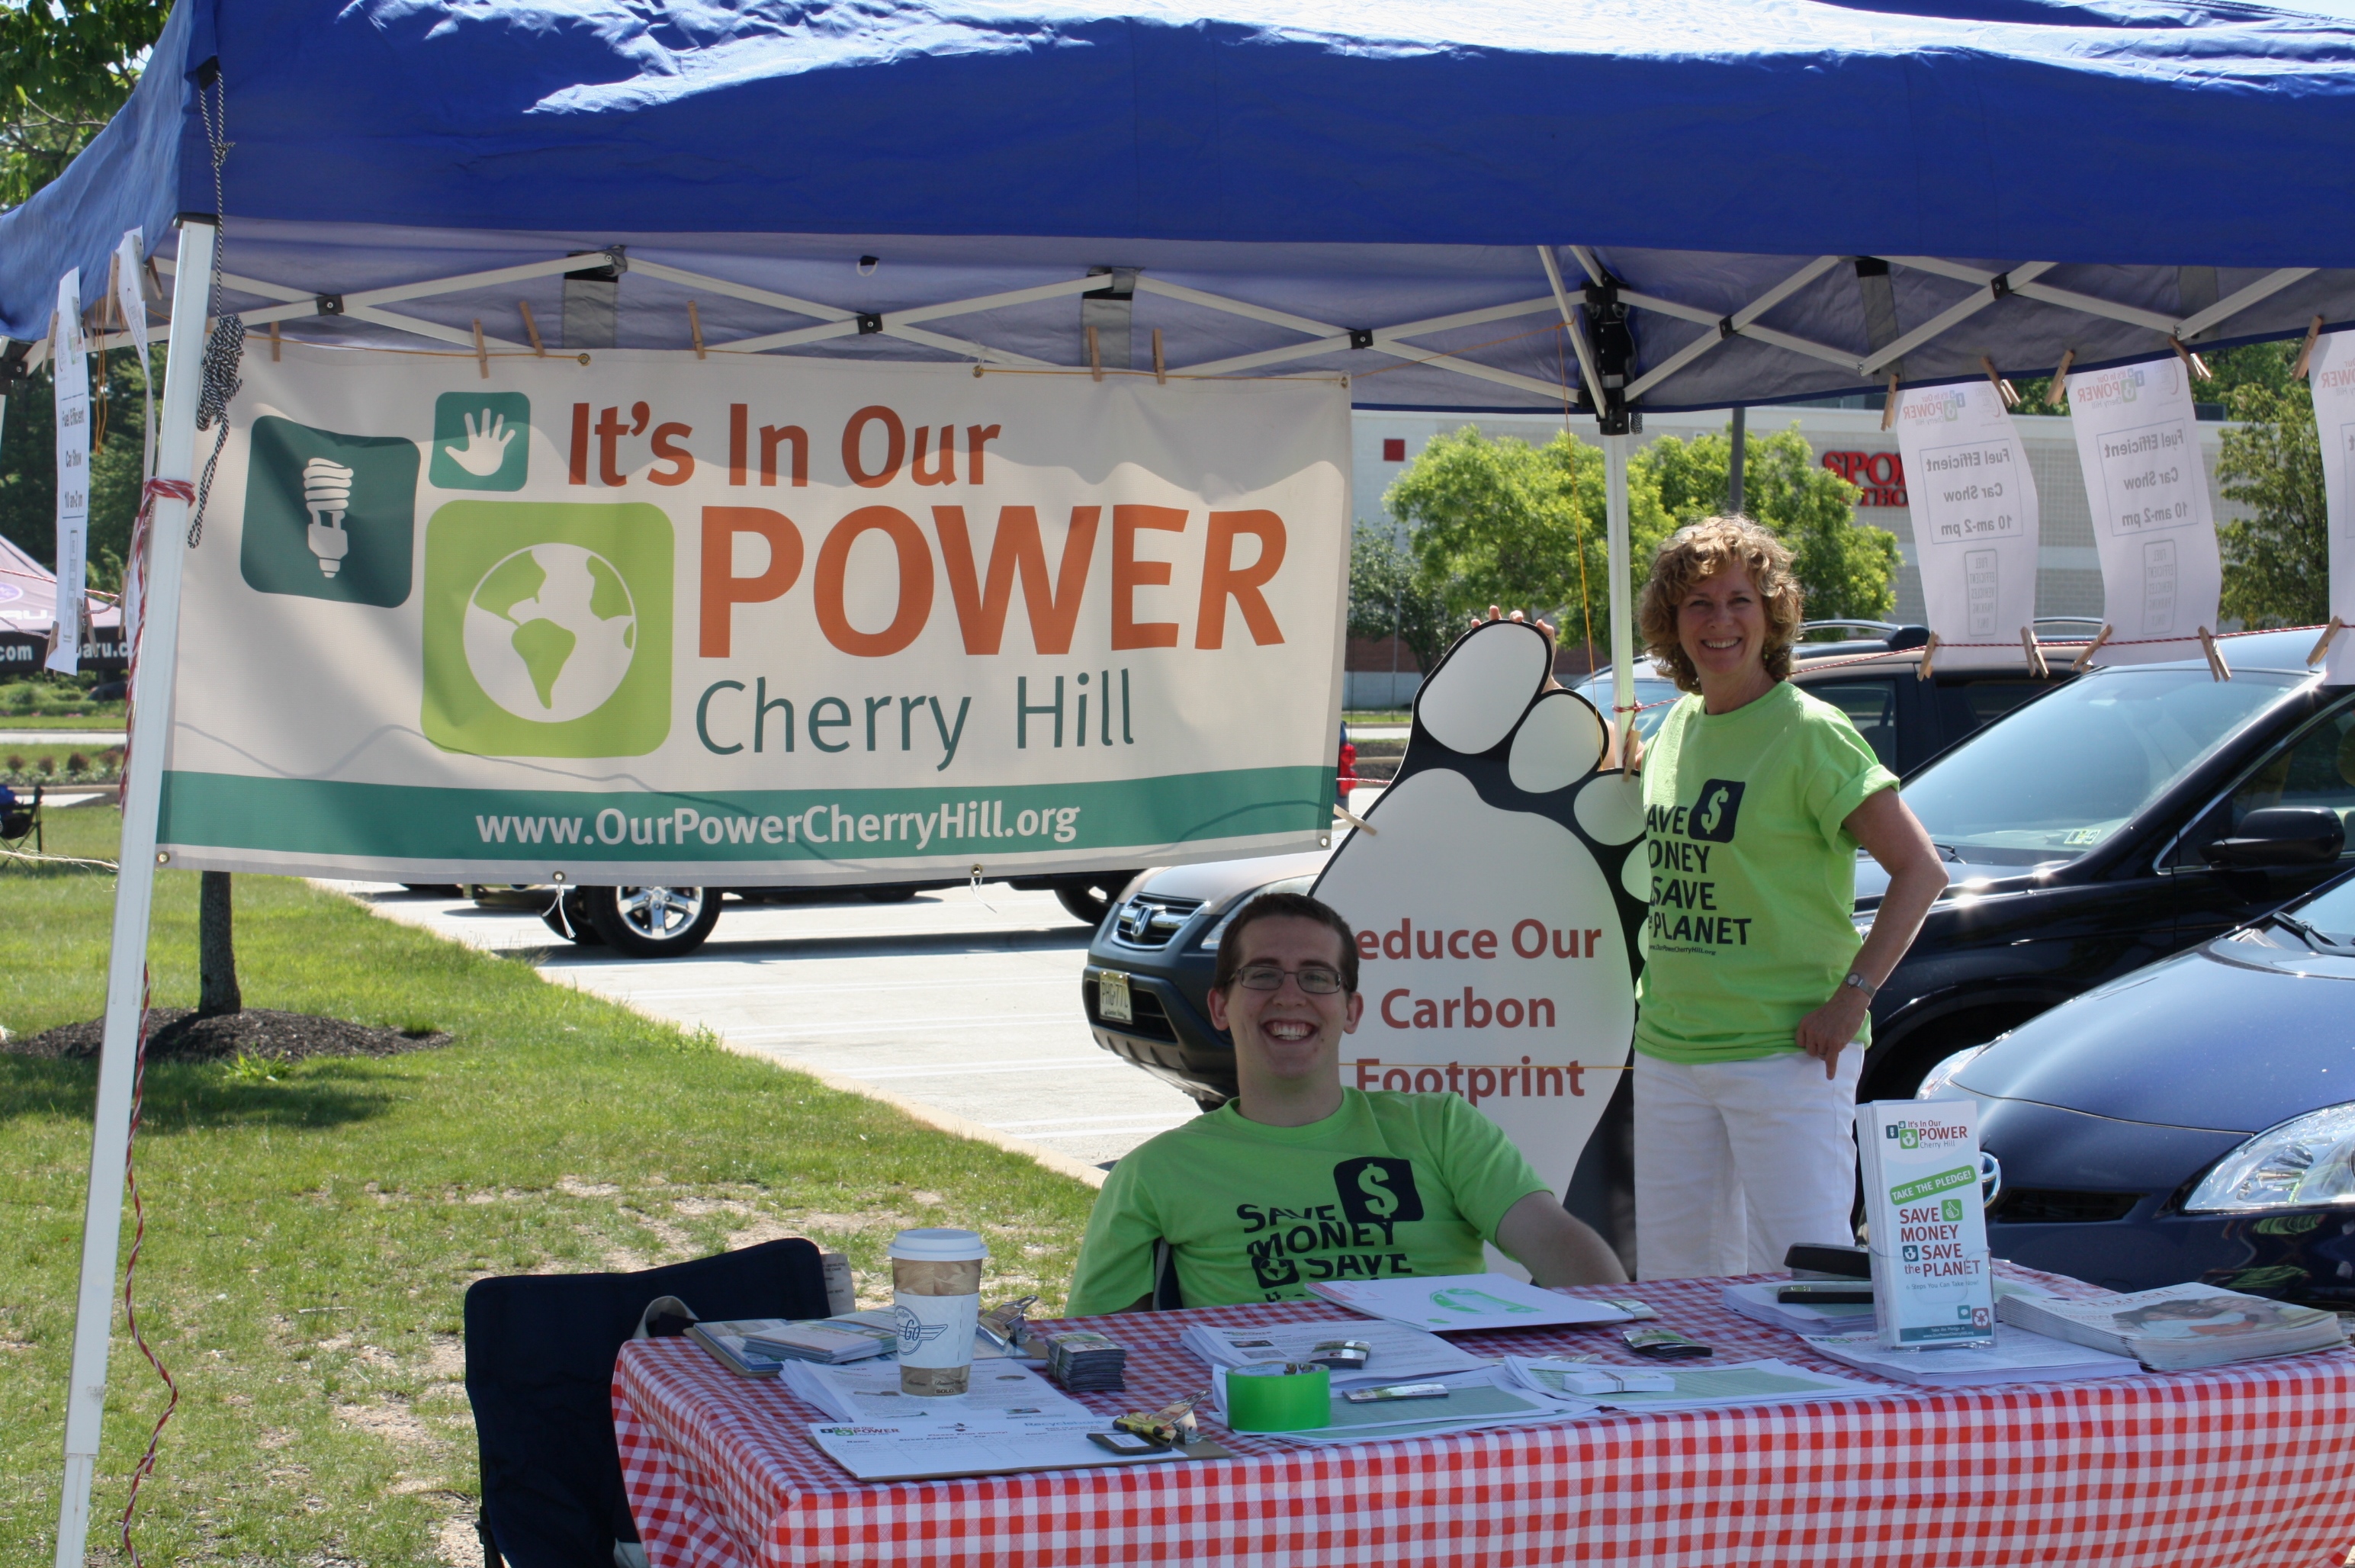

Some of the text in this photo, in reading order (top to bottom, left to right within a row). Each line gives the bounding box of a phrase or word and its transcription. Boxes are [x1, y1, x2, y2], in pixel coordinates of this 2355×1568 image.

[568, 400, 1002, 489] It's In Our
[698, 503, 1287, 659] POWER
[696, 668, 1134, 773] Cherry Hill
[476, 802, 1081, 851] www.OurPowerCherryHill.org
[1645, 804, 1688, 835] AVE
[1648, 840, 1711, 874] ONEY
[1354, 917, 1602, 960] educe Our
[1653, 911, 1752, 945] PLANET
[1380, 986, 1556, 1029] Carbon
[1356, 1056, 1585, 1107] Footprint
[1919, 1126, 1968, 1140] POWER
[1891, 1170, 1972, 1201] TAKE THE PLEDGE!
[1236, 1203, 1337, 1234] SAVE
[1899, 1207, 1940, 1224] SAVE
[1246, 1221, 1394, 1258] MONEY
[1900, 1224, 1958, 1242] MONEY
[1303, 1252, 1413, 1279] SAVE
[1904, 1260, 1981, 1277] the PLANET
[1921, 1243, 1963, 1261] SAVE
